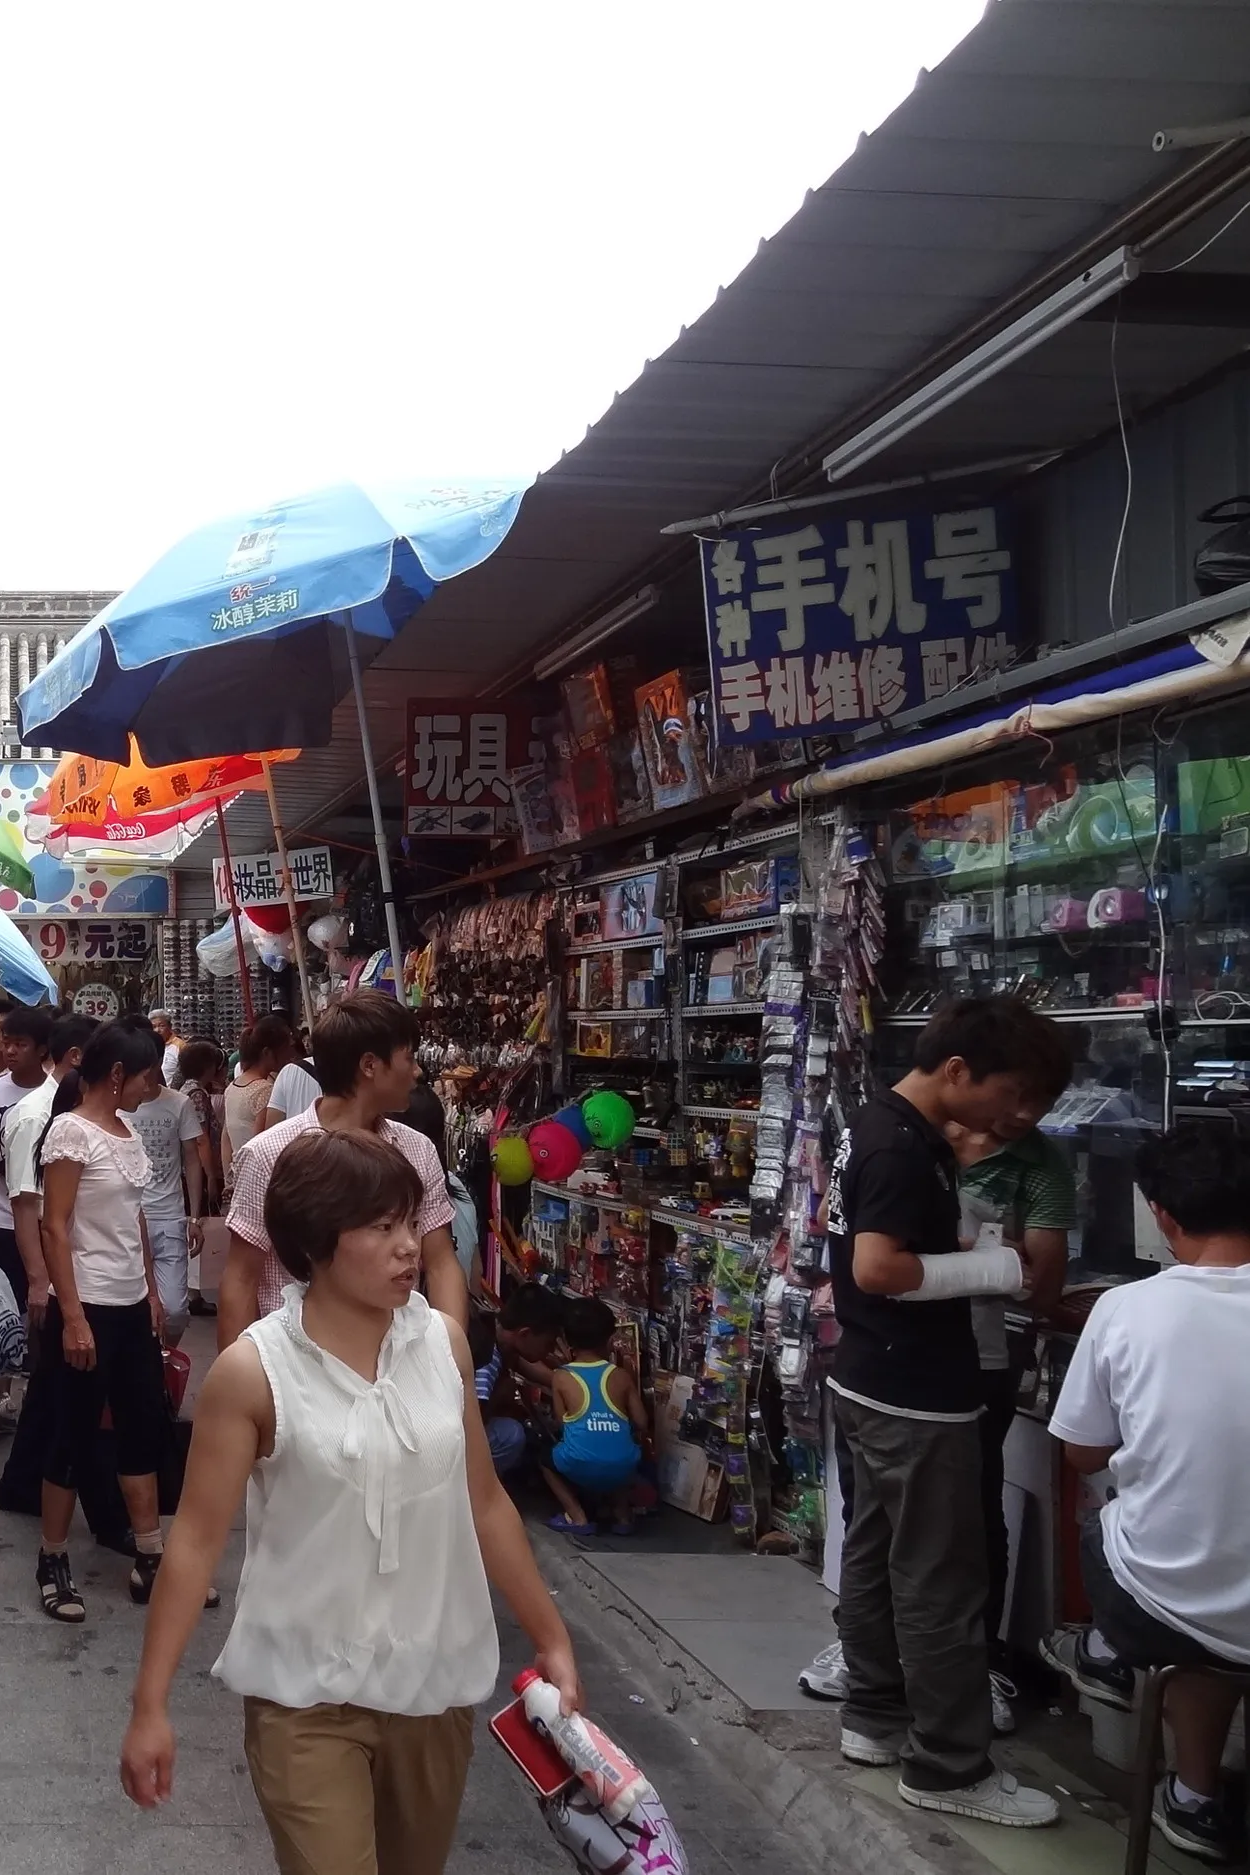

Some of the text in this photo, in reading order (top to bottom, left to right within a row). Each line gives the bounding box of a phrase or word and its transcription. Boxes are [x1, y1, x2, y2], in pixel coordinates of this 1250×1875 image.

[711, 507, 1011, 658] 各种 手机号
[211, 588, 299, 632] 冰醇茉莉
[720, 645, 907, 733] 手机维修
[85, 1000, 108, 1016] 39
[586, 1418, 620, 1432] time
